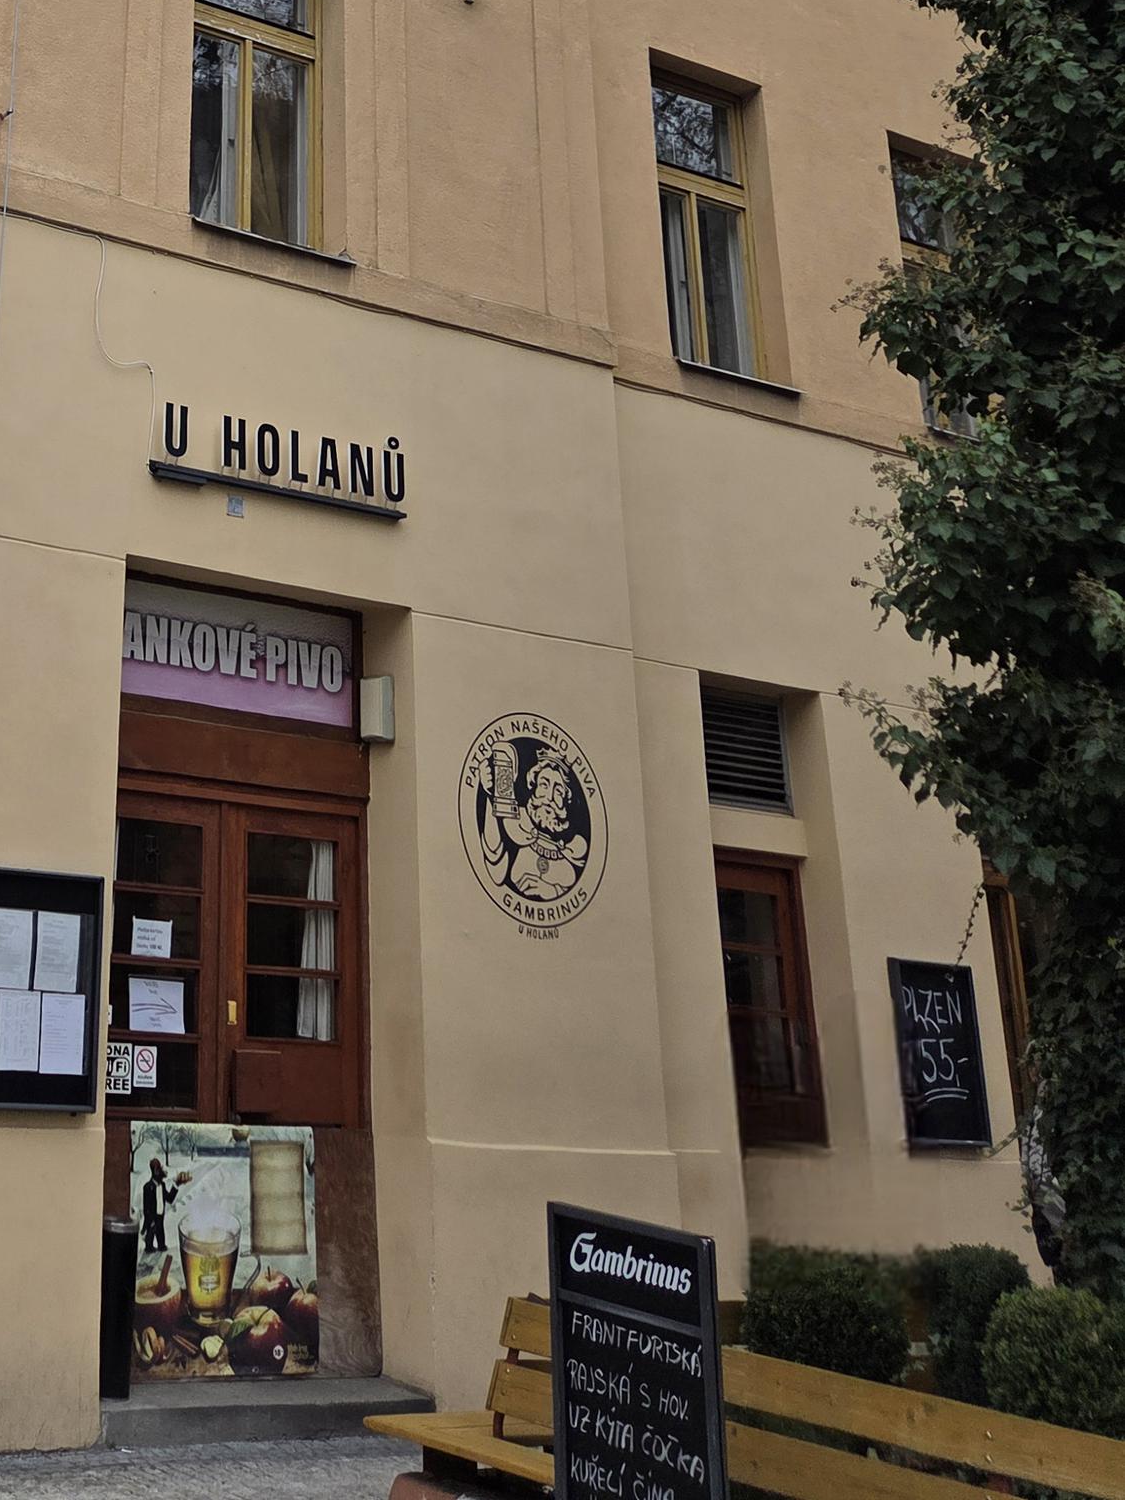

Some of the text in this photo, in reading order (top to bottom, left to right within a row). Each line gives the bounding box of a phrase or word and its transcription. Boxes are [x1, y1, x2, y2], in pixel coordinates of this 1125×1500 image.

[164, 400, 406, 502] U HOLANŮ
[266, 634, 345, 695] PIVO
[465, 718, 597, 800] PATRON NAŠEHO PIVA
[501, 887, 589, 923] GAMBRINUS
[517, 924, 525, 936] U
[569, 1232, 692, 1295] Gambrinus
[566, 1358, 689, 1420] RAJSKÁ S HOV.
[570, 1452, 626, 1498] KUŘECÍ
[641, 1424, 705, 1485] ČOČKA
